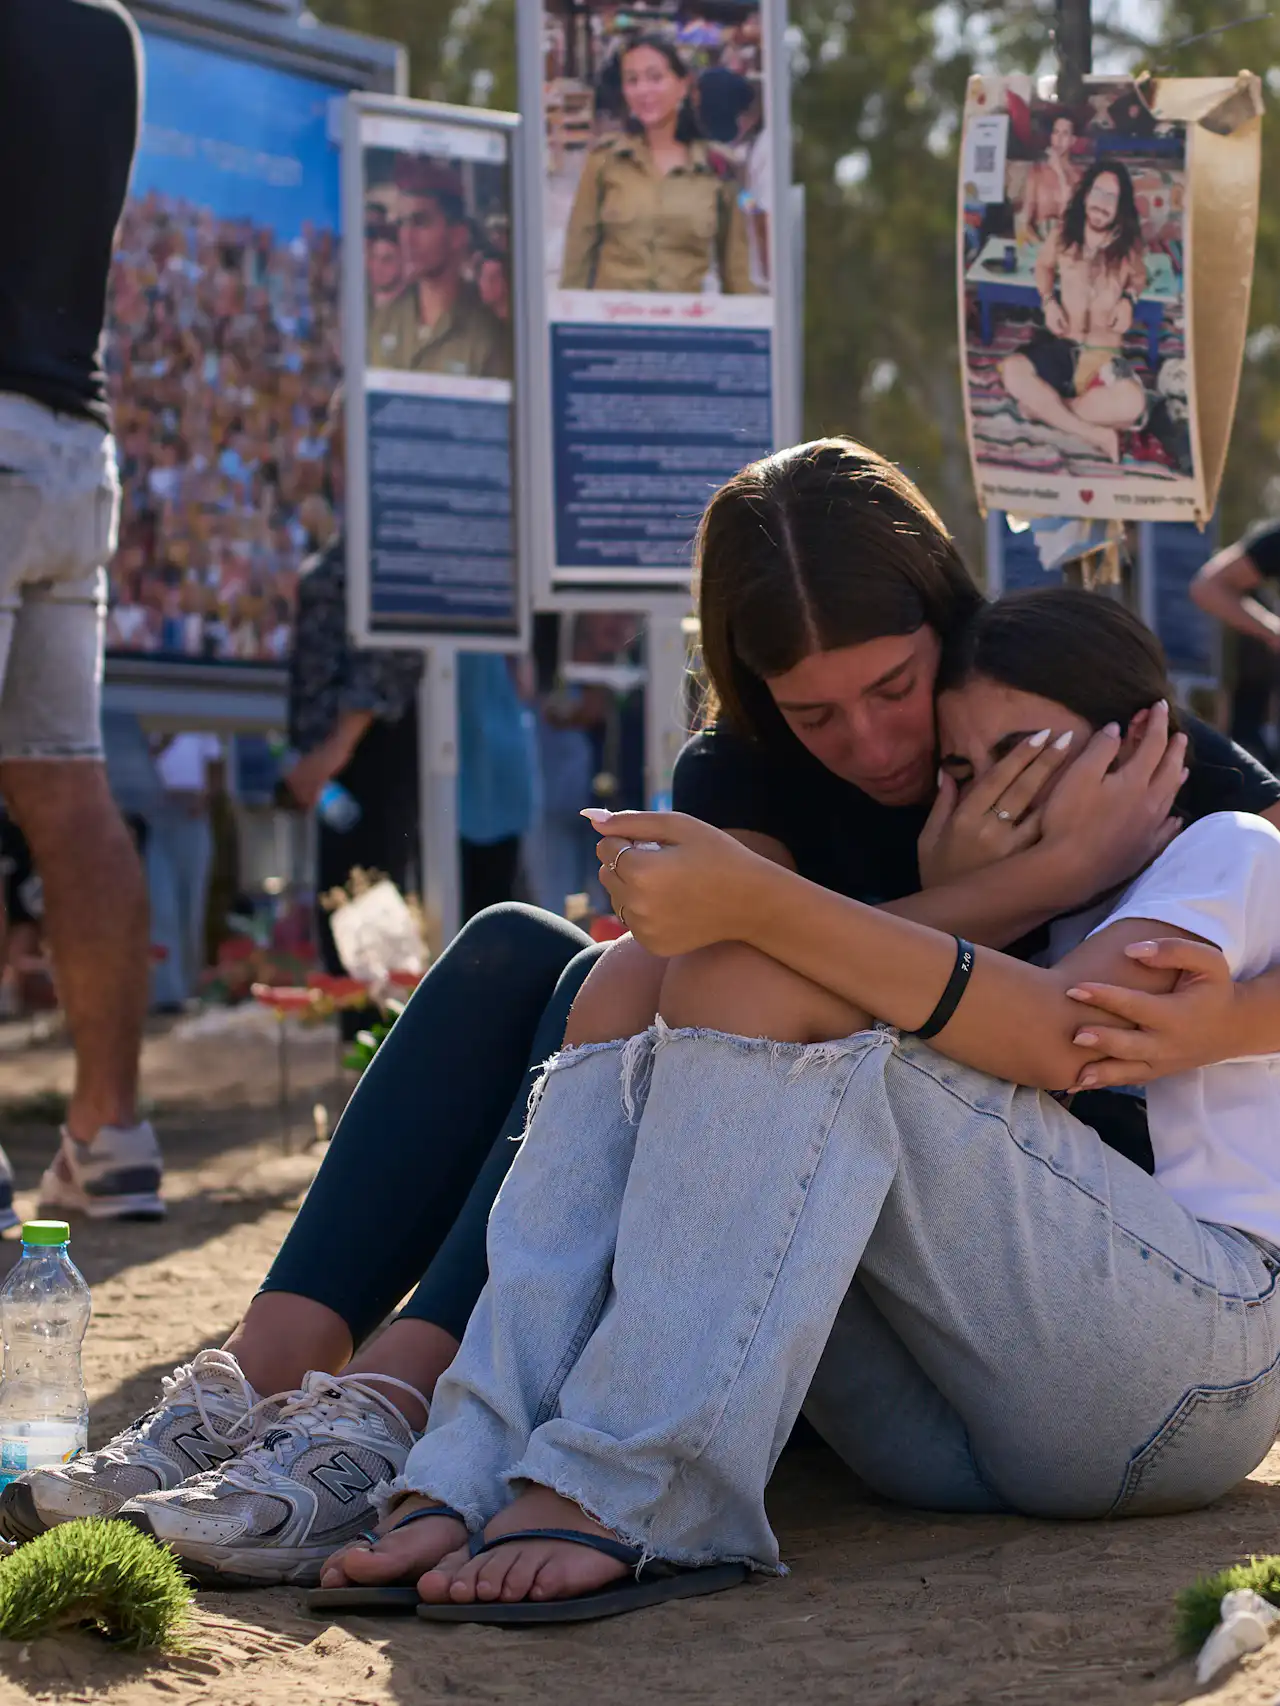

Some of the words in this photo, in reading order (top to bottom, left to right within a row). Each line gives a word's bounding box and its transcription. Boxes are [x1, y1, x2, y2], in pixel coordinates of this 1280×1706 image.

[961, 952, 972, 972] 7.10
[173, 1423, 237, 1472] N
[308, 1451, 375, 1504] N
